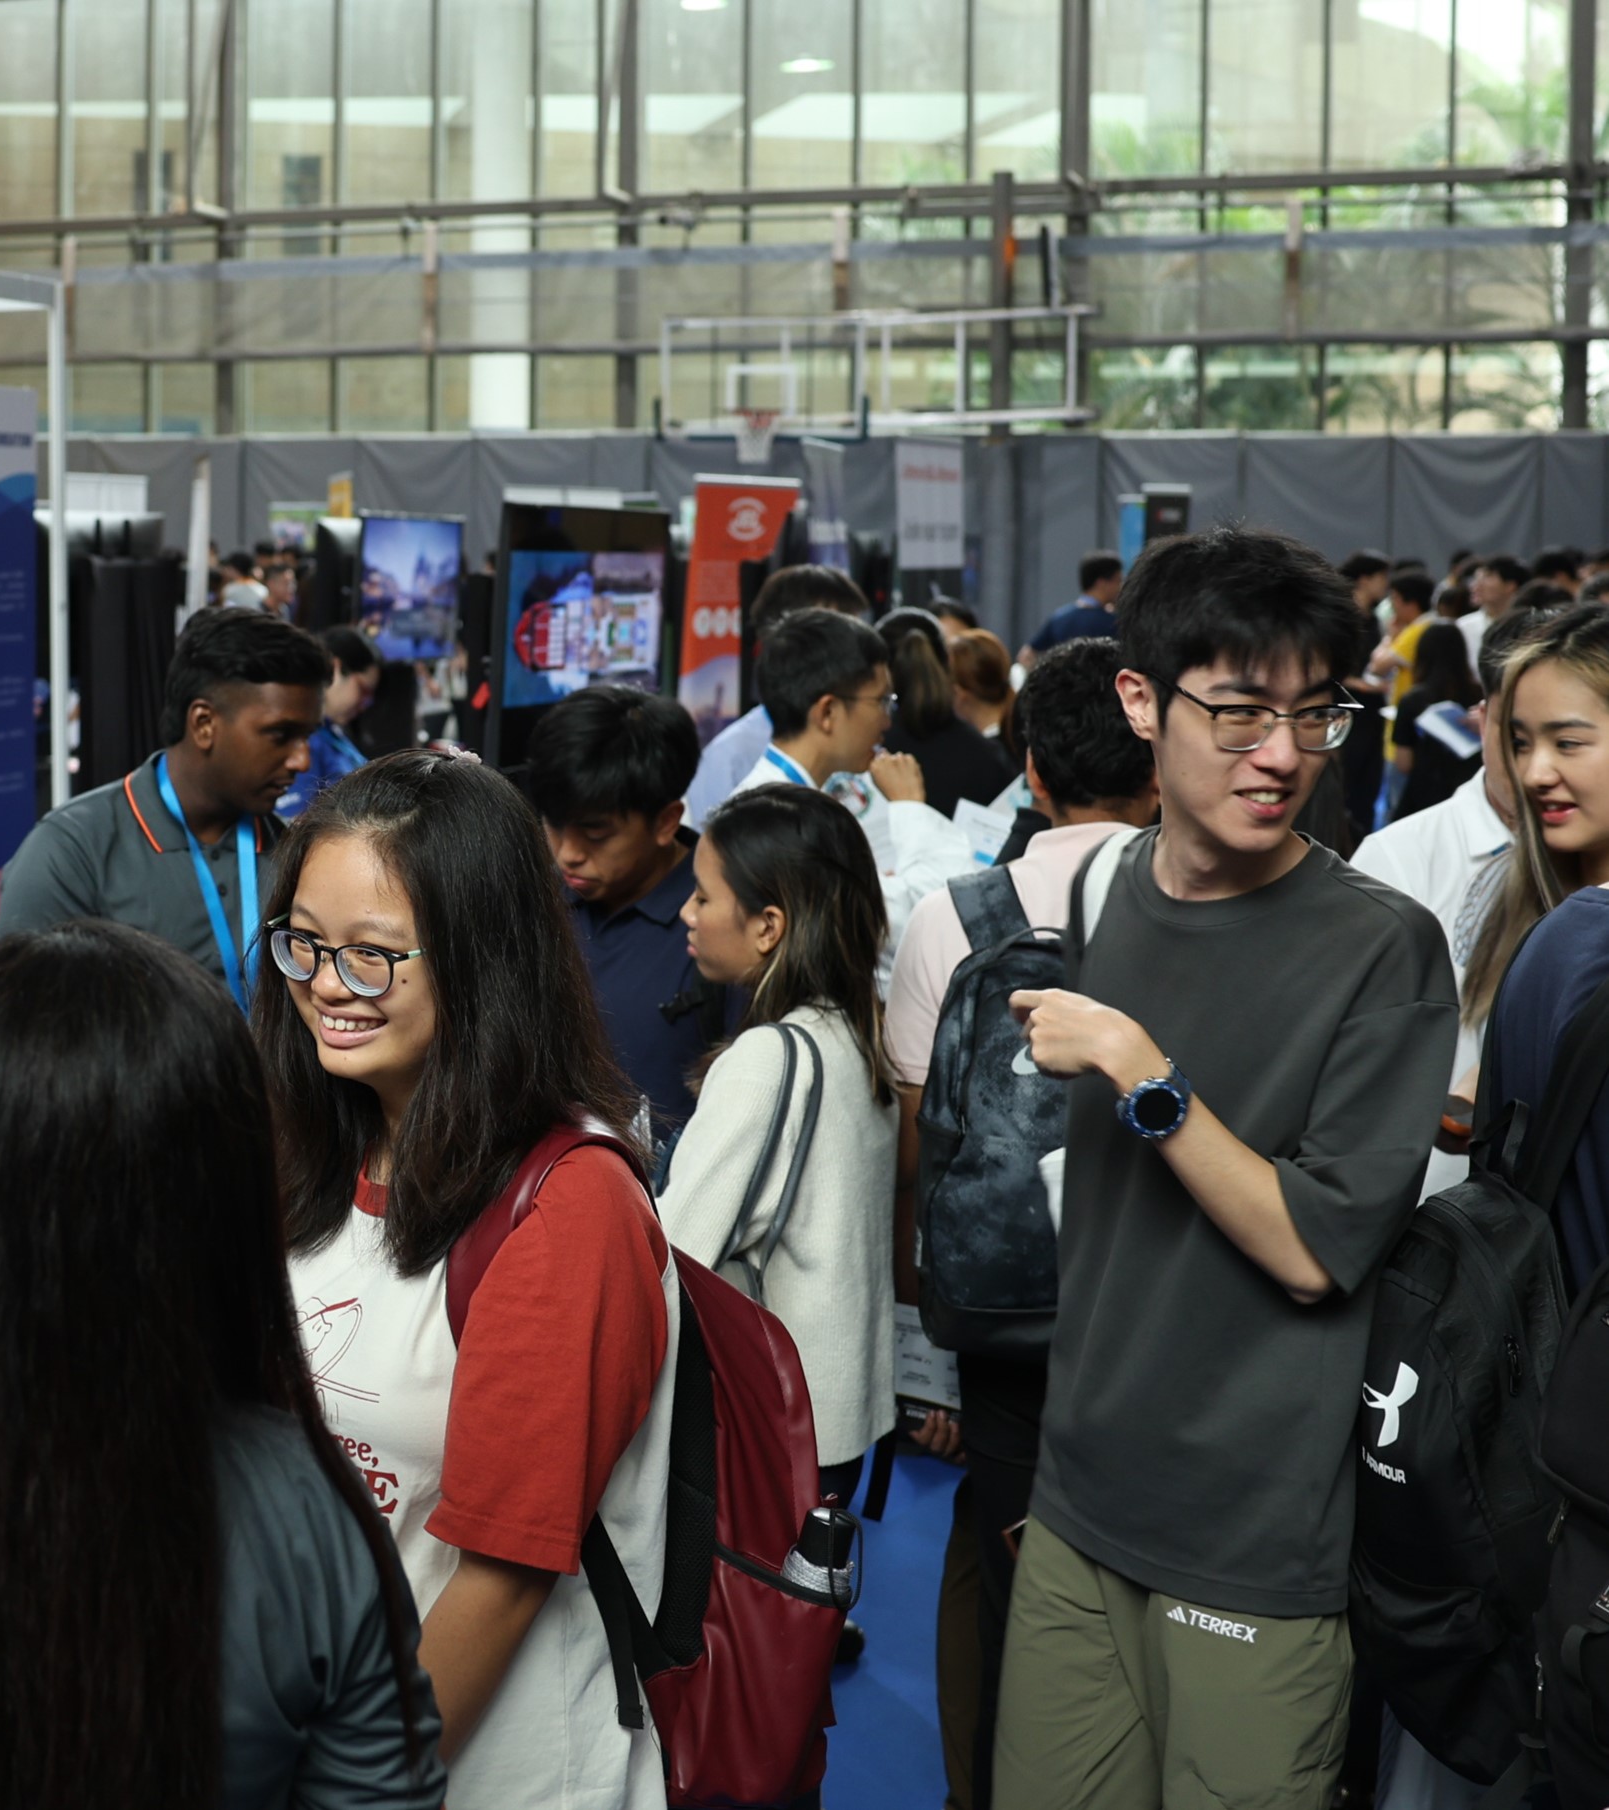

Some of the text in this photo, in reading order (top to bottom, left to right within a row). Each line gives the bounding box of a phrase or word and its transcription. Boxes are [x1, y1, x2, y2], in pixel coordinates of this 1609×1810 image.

[1366, 1451, 1407, 1485] ARMOUR
[358, 1466, 399, 1514] E
[1189, 1608, 1258, 1643] TERREX
